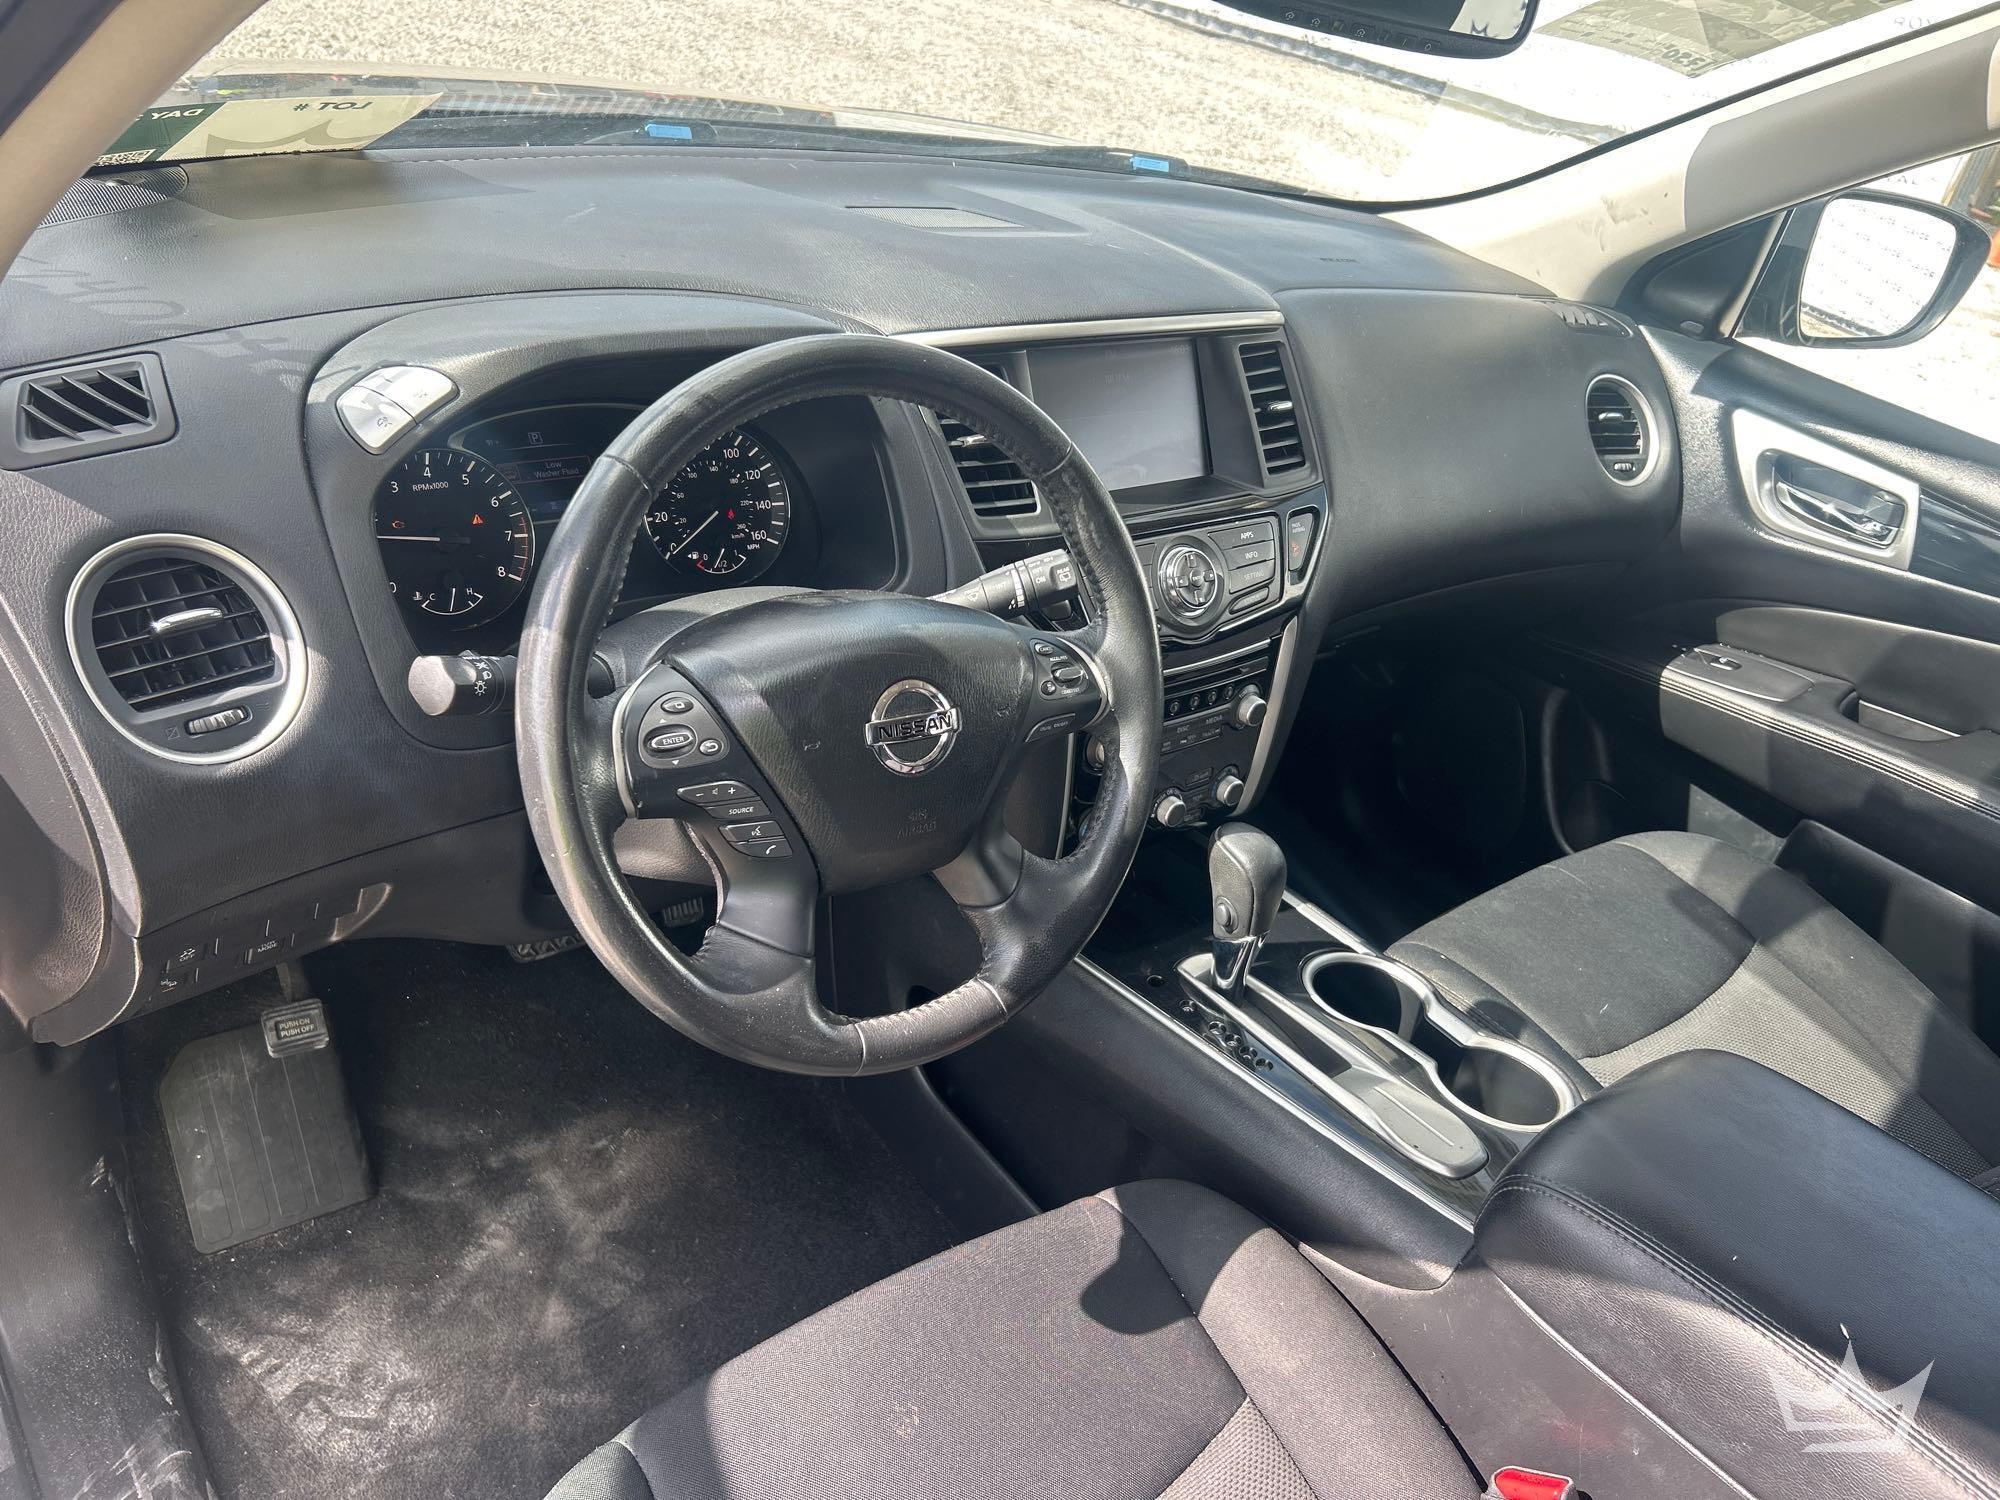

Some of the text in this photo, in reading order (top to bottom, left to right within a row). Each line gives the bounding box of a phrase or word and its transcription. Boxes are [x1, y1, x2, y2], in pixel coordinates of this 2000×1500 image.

[723, 448, 740, 460] 100
[545, 461, 562, 470] Low
[424, 467, 431, 478] 4
[534, 467, 580, 480] Washer Fluid
[745, 469, 761, 481] 120
[462, 474, 470, 486] 5
[391, 481, 399, 494] 3
[412, 481, 449, 493] RPMx1000
[491, 497, 499, 509] 6
[755, 500, 772, 511] 140
[654, 511, 668, 523] 20
[504, 530, 513, 542] 7
[751, 530, 768, 541] 160
[1240, 531, 1254, 540] APPS
[747, 543, 760, 551] MPH
[1245, 551, 1258, 560] INFO
[497, 566, 506, 578] 8
[1057, 567, 1070, 575] REAR
[1035, 576, 1046, 584] ON
[429, 593, 436, 601] C
[467, 588, 473, 596] H
[877, 714, 953, 741] NISSAN
[1176, 724, 1190, 734] DISC
[662, 736, 685, 745] ENTER
[728, 806, 754, 815] SOURCE
[257, 942, 278, 953] MODE
[179, 953, 195, 963] OFF
[279, 1017, 310, 1030] PUSH ON
[281, 1024, 314, 1038] PUSH OFF
